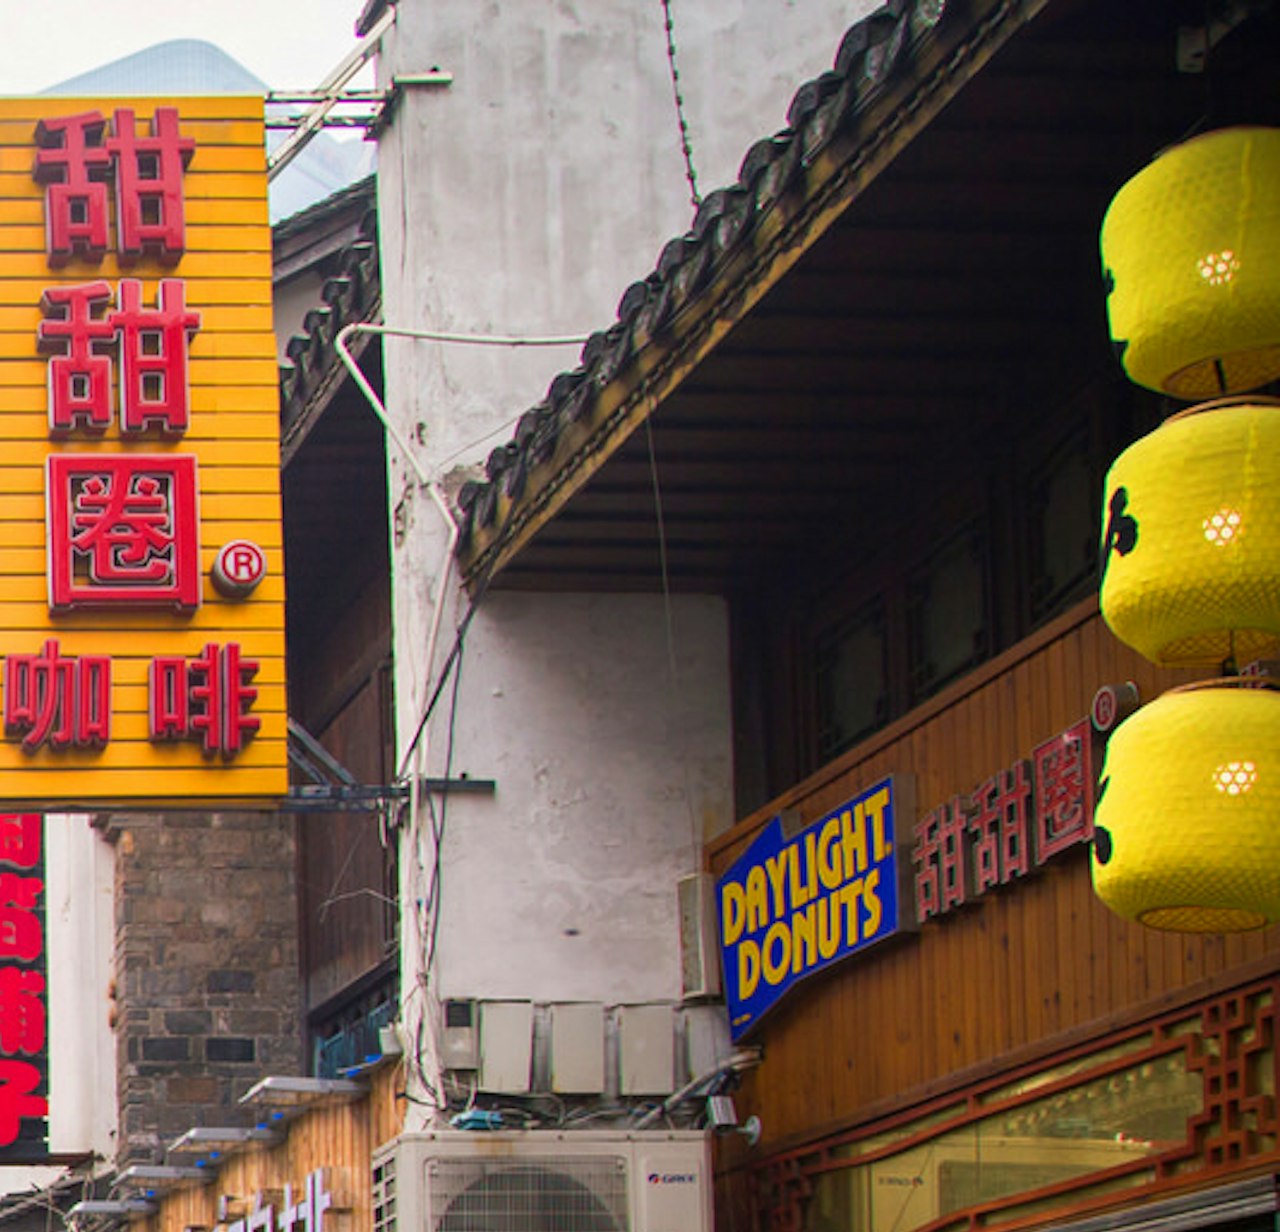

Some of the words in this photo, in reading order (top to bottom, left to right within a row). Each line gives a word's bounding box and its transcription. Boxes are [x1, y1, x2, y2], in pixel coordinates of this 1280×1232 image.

[34, 107, 201, 617] 甜甜圈
[3, 639, 262, 759] 咖啡
[722, 786, 893, 946] DAYLIGHT
[913, 716, 1094, 923] 甜甜圈
[739, 869, 883, 1001] DONUTS
